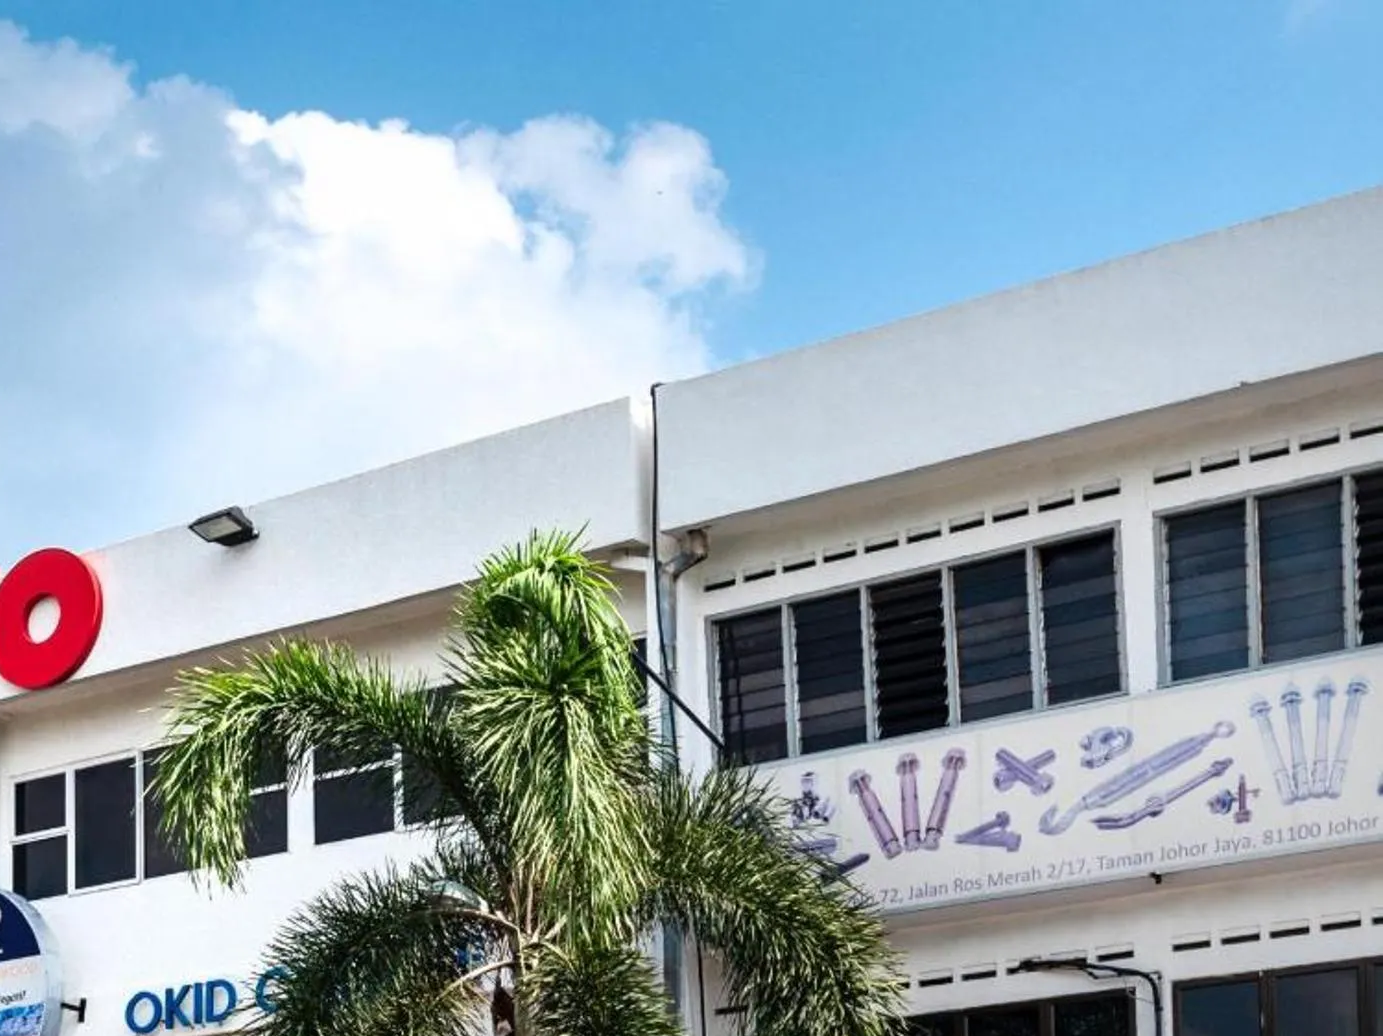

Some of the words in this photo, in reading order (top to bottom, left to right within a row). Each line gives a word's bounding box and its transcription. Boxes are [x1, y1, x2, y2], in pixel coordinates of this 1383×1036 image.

[908, 880, 948, 900] Jalan
[954, 877, 982, 895] Ros
[987, 868, 1041, 887] Merah
[1047, 858, 1091, 879] 2/17,
[1097, 852, 1154, 871] Taman
[1159, 842, 1208, 862] Johor
[1263, 824, 1321, 846] 81100
[1327, 816, 1378, 836] Johor
[125, 979, 237, 1035] OKID
